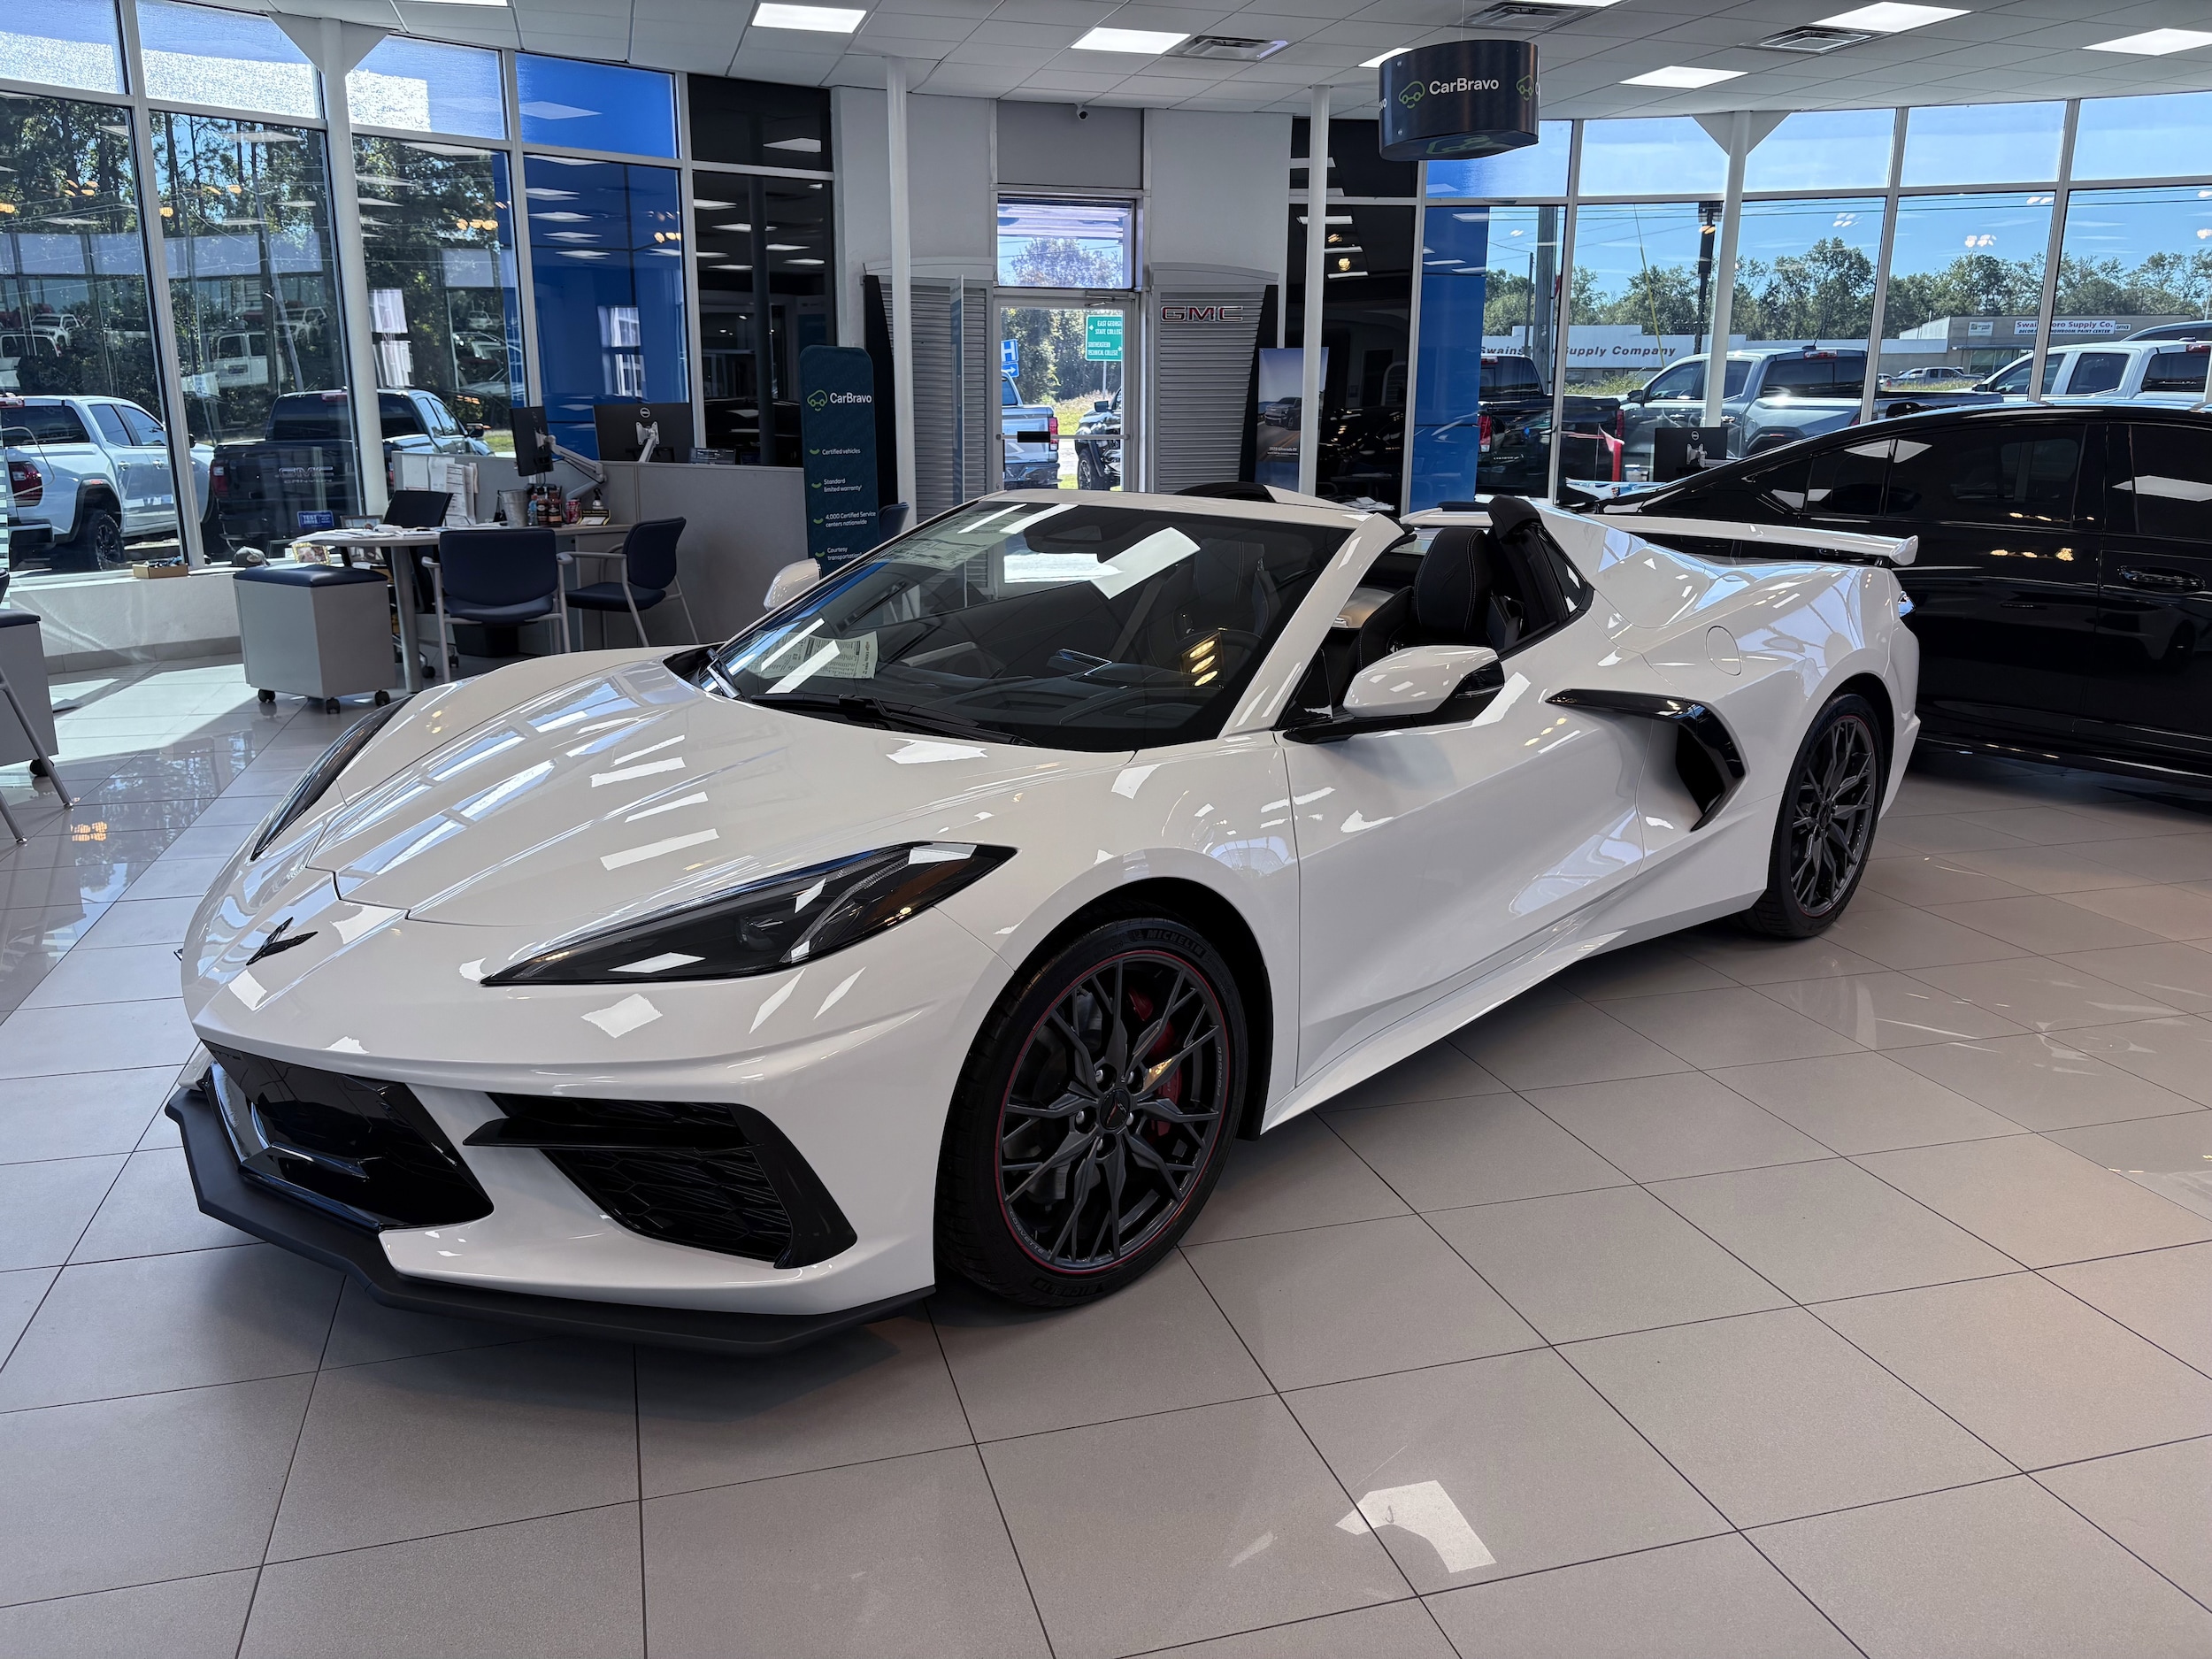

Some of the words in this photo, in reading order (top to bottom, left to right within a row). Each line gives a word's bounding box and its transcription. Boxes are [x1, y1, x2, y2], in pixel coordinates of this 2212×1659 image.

[1429, 77, 1500, 96] CarBravo
[1161, 305, 1243, 322] GMC
[1001, 342, 1016, 362] H
[1612, 346, 1677, 357] Company
[830, 392, 872, 403] CarBravo
[279, 466, 334, 479] GMC
[1146, 929, 1204, 956] MICHELIN
[1009, 1210, 1045, 1255] CORVETTE
[1033, 1279, 1098, 1297] MICHELIN
